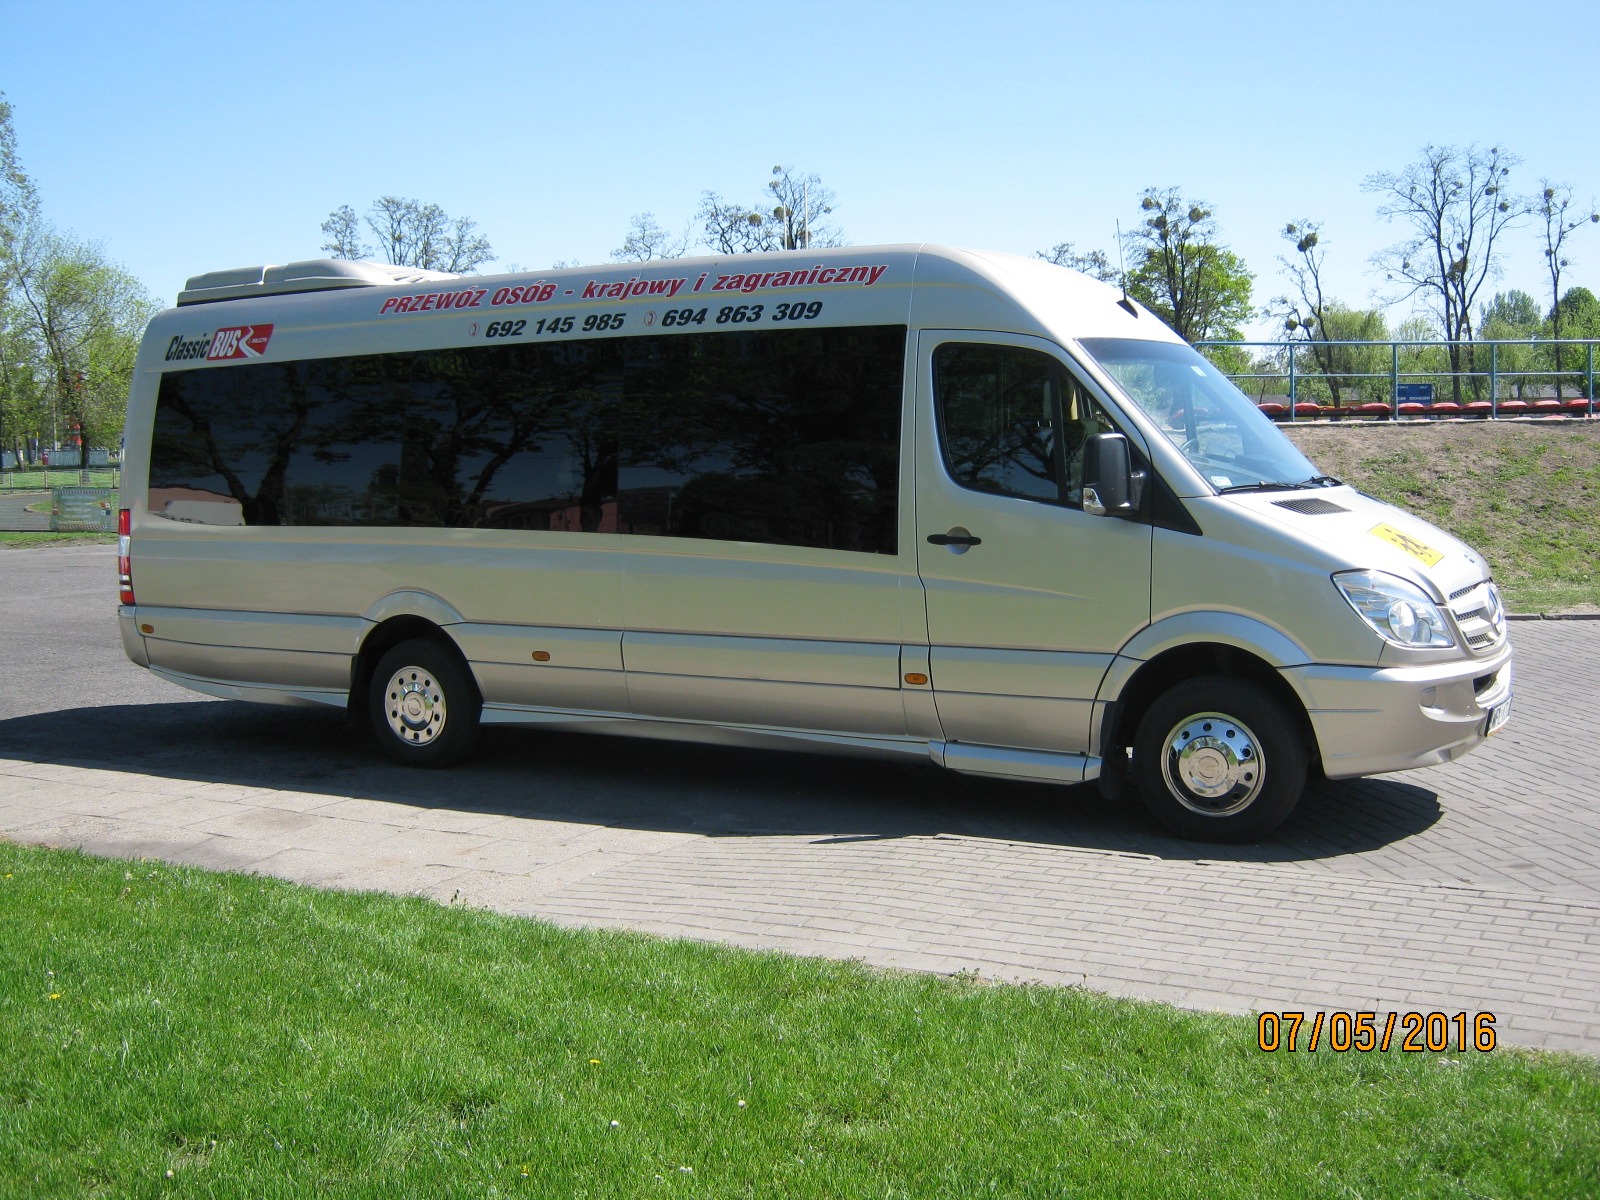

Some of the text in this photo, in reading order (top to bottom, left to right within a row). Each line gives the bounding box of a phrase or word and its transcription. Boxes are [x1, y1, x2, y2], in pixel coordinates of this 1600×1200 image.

[379, 285, 489, 315] PRZEWÓZ
[491, 280, 558, 306] OSÓB
[581, 276, 687, 301] krajowy
[692, 272, 709, 292] i
[711, 264, 889, 294] zagraniczny
[485, 312, 627, 338] 692 145 985
[661, 301, 823, 327] 694 863 309
[165, 329, 242, 361] Classic BUS
